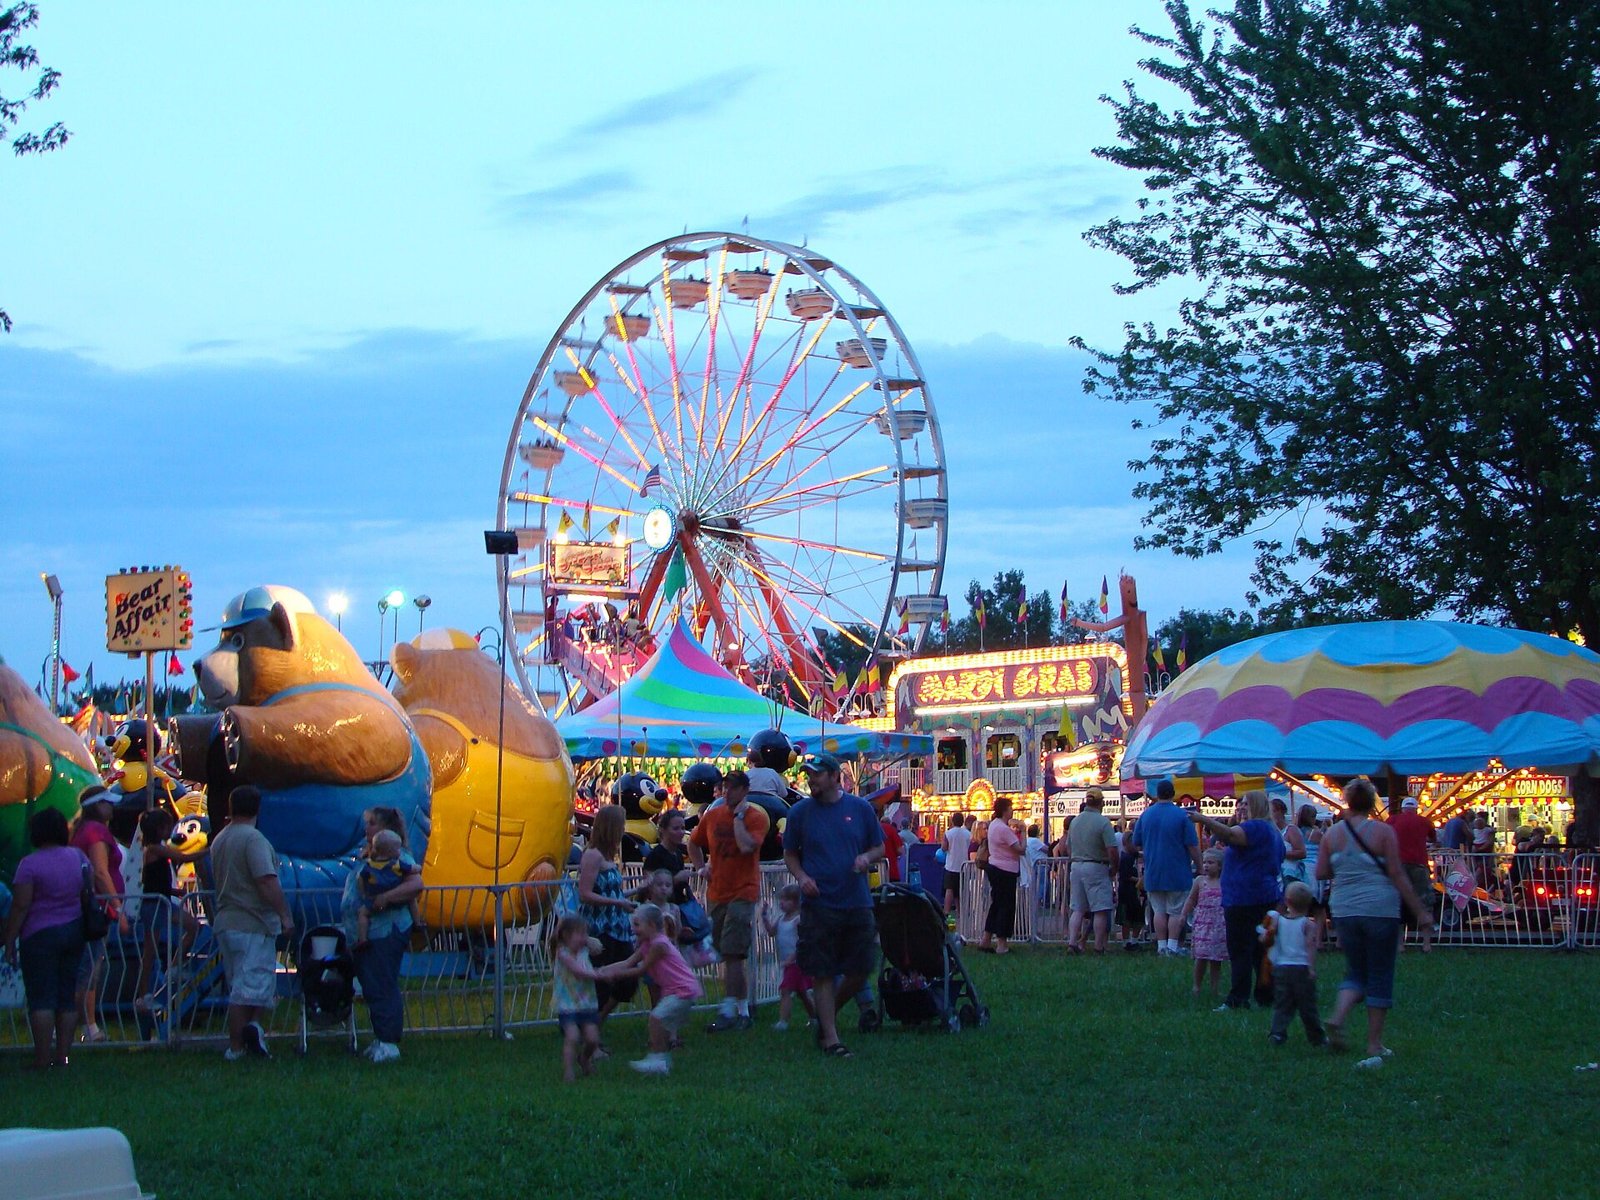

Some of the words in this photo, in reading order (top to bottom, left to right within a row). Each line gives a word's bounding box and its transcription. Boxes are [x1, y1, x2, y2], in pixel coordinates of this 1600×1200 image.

[112, 593, 171, 641] Affair
[115, 577, 163, 618] Bear
[1012, 660, 1093, 697] GRAS
[1515, 780, 1538, 795] CORN
[1539, 779, 1562, 795] DOGS
